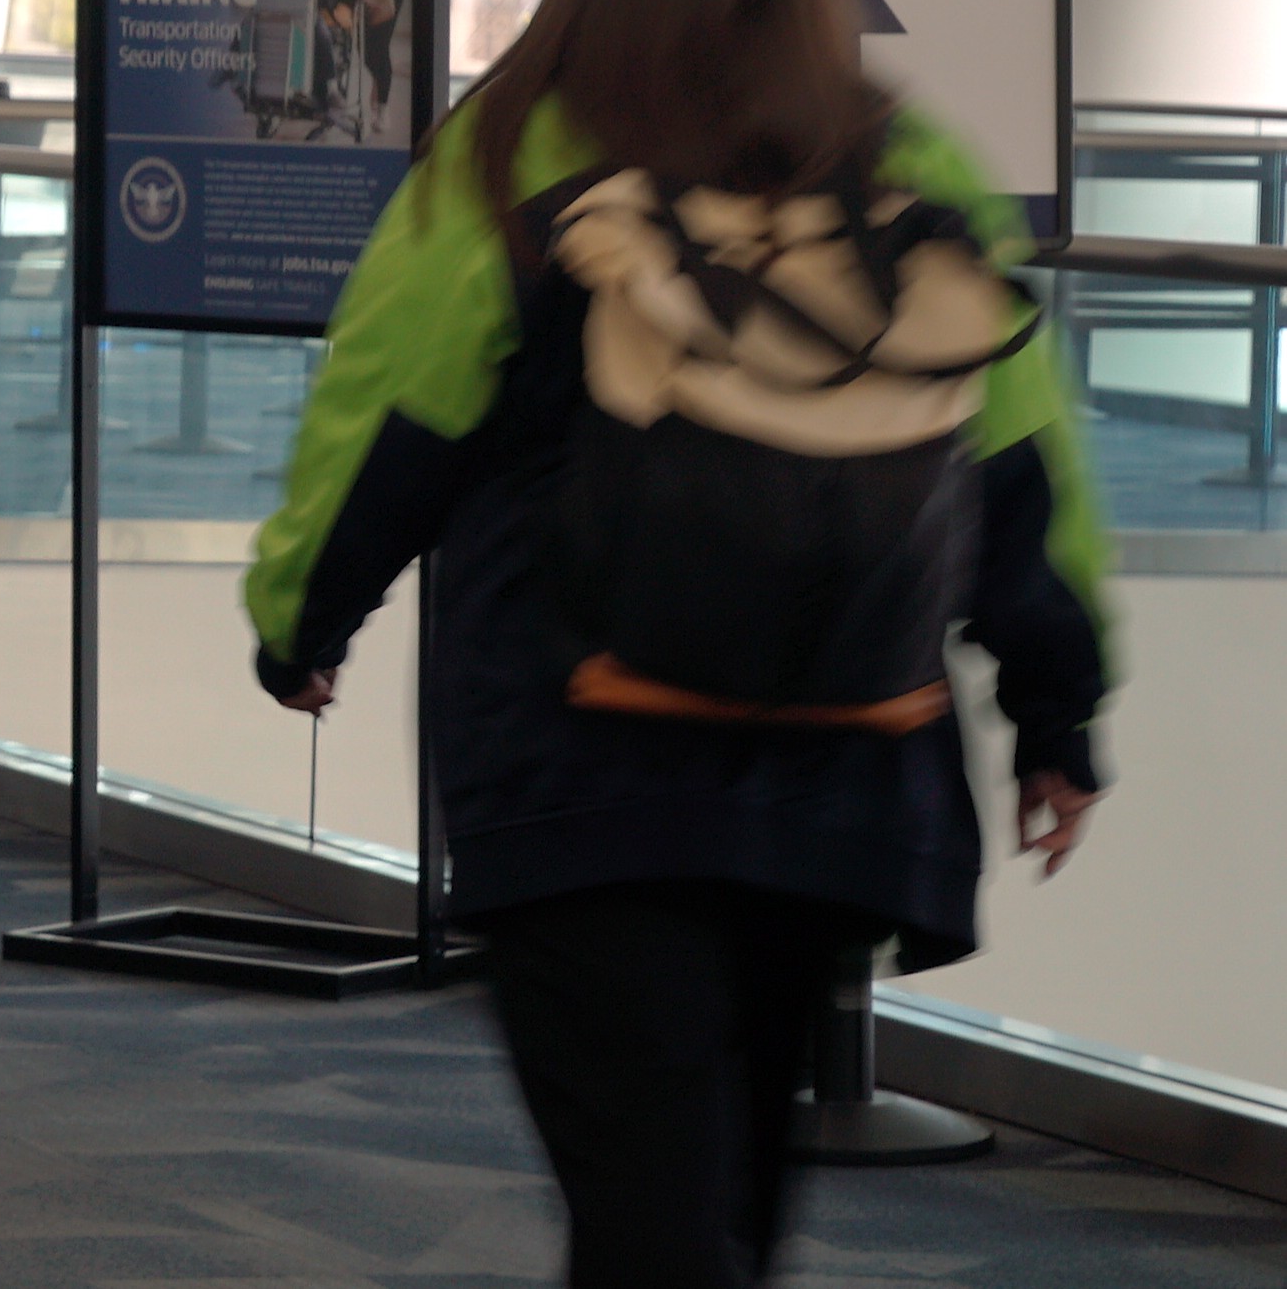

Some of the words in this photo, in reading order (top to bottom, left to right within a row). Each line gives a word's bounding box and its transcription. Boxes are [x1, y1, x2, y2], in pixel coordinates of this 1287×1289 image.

[120, 15, 242, 41] Transportation
[119, 45, 186, 72] Security
[191, 46, 257, 72] Officers
